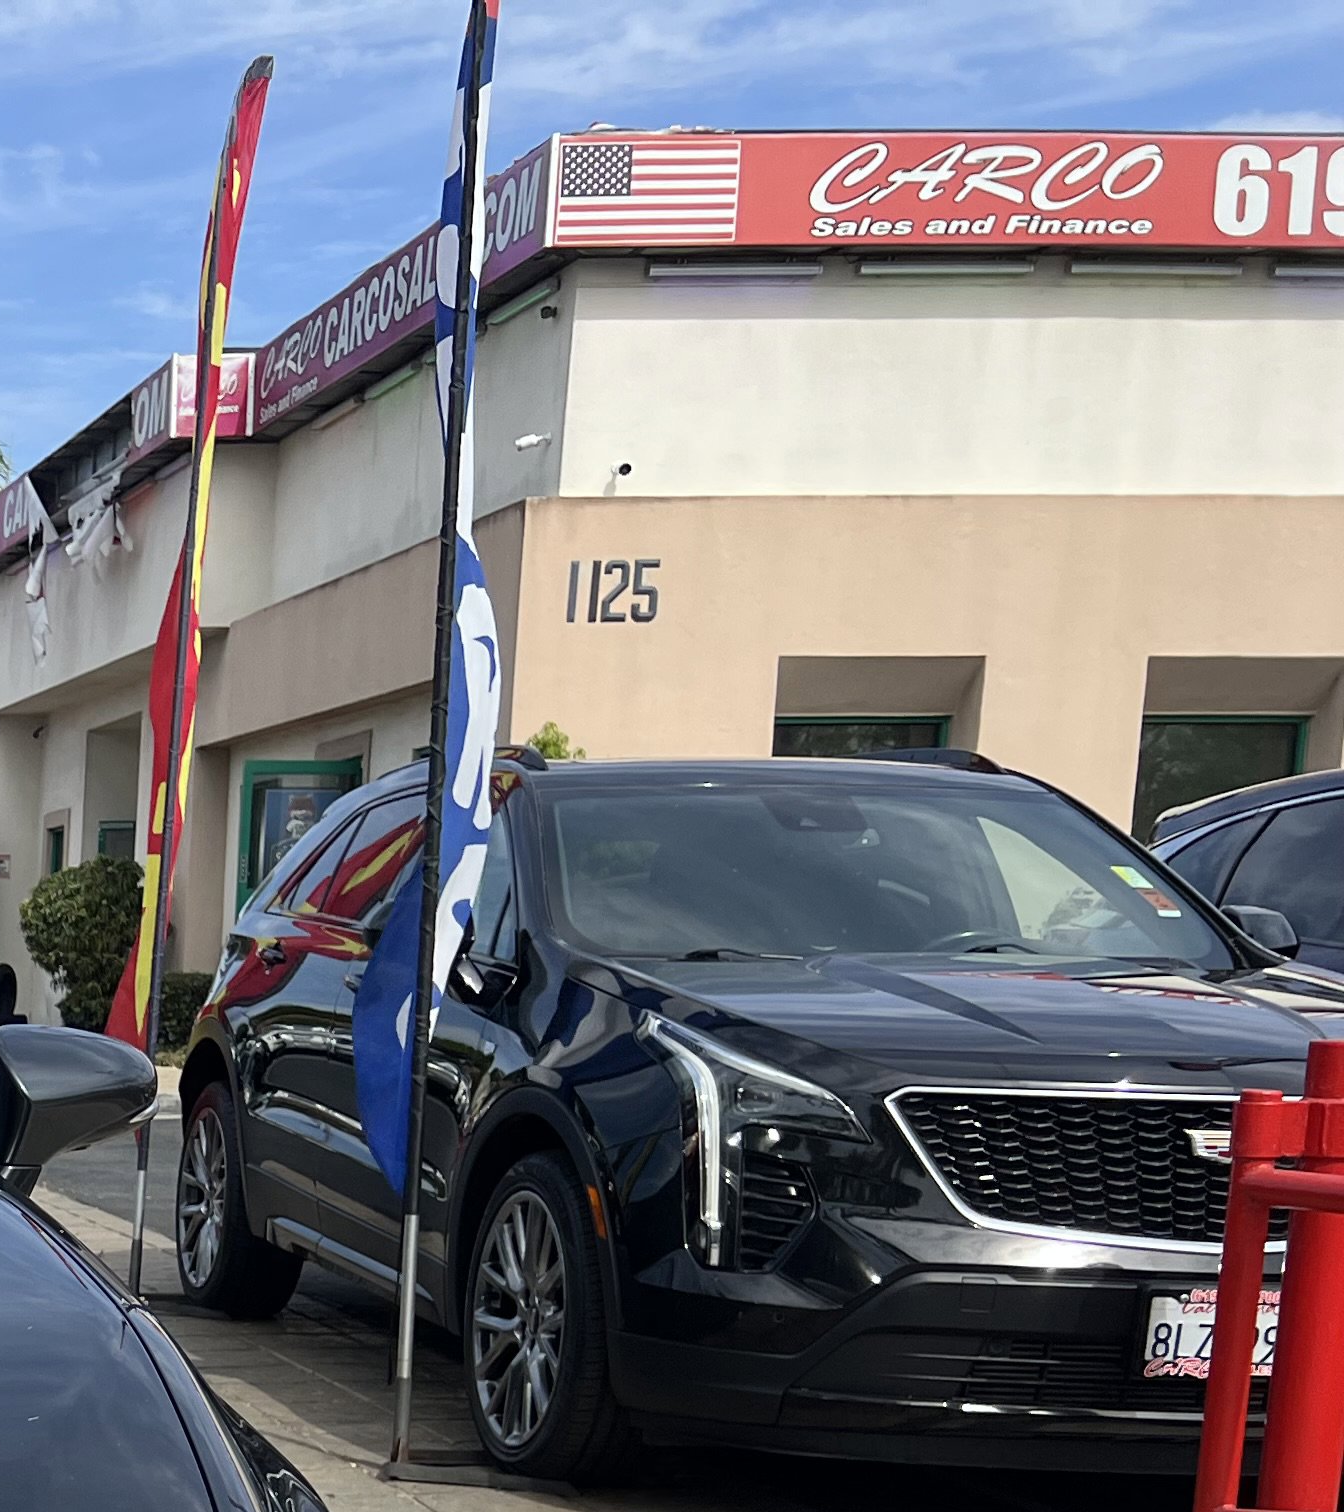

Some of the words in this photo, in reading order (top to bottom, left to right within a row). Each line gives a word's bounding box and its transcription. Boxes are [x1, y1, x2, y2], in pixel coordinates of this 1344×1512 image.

[809, 141, 1164, 214] CARCO
[810, 217, 914, 237] Sales
[924, 214, 996, 235] and
[1004, 214, 1154, 236] Finance
[566, 558, 661, 622] 1125
